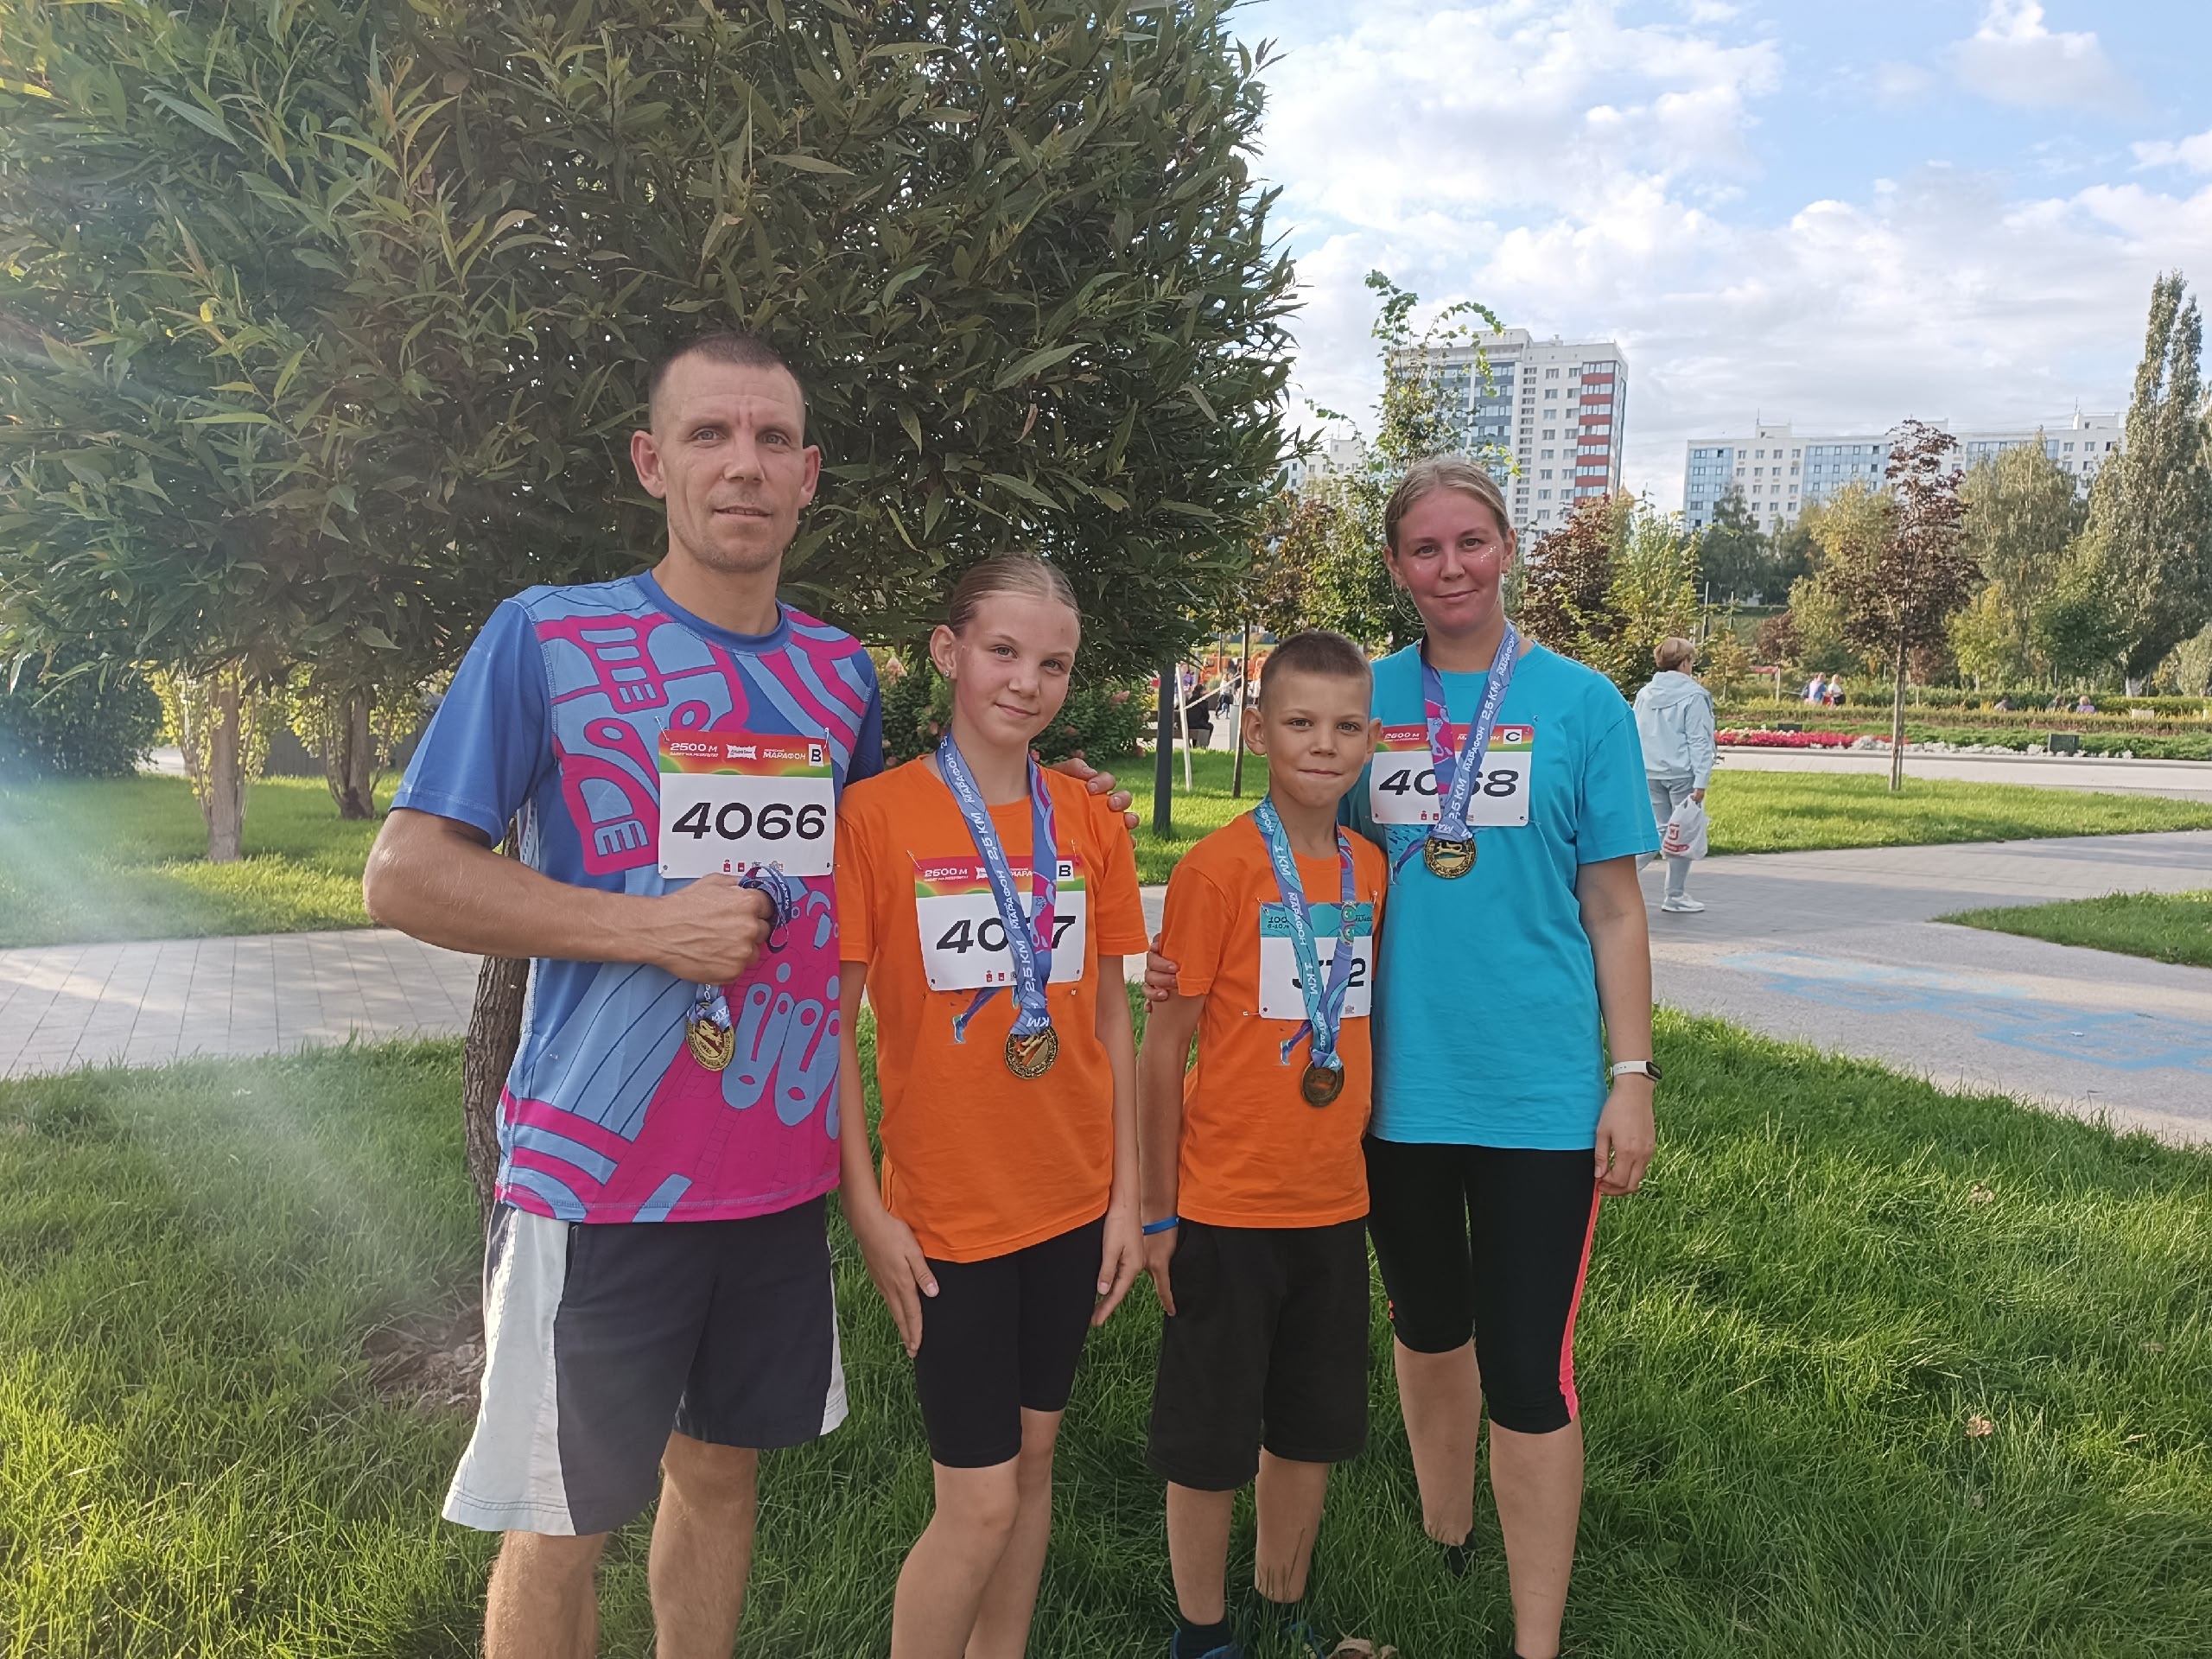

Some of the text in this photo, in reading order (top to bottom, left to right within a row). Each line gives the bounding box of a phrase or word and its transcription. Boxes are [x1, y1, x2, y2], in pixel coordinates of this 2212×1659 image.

[1465, 726, 1485, 772] МАРАФОН
[1481, 700, 1494, 720] 2,5
[1488, 680, 1501, 700] КМ
[1497, 634, 1515, 677] МАРАФОН
[670, 743, 706, 752] 2500
[944, 753, 975, 803] МАРАФОН
[671, 802, 827, 841] 4066
[970, 812, 988, 834] КМ
[982, 836, 998, 861] 2,5
[925, 868, 957, 877] 2500
[996, 870, 1020, 929] МАРАФОН
[936, 915, 1076, 954] 407
[1015, 940, 1031, 963] КМ
[1023, 967, 1036, 992] 2,5
[1287, 892, 1306, 946] МАРАФОН
[1316, 1010, 1328, 1051] МАРАФ
